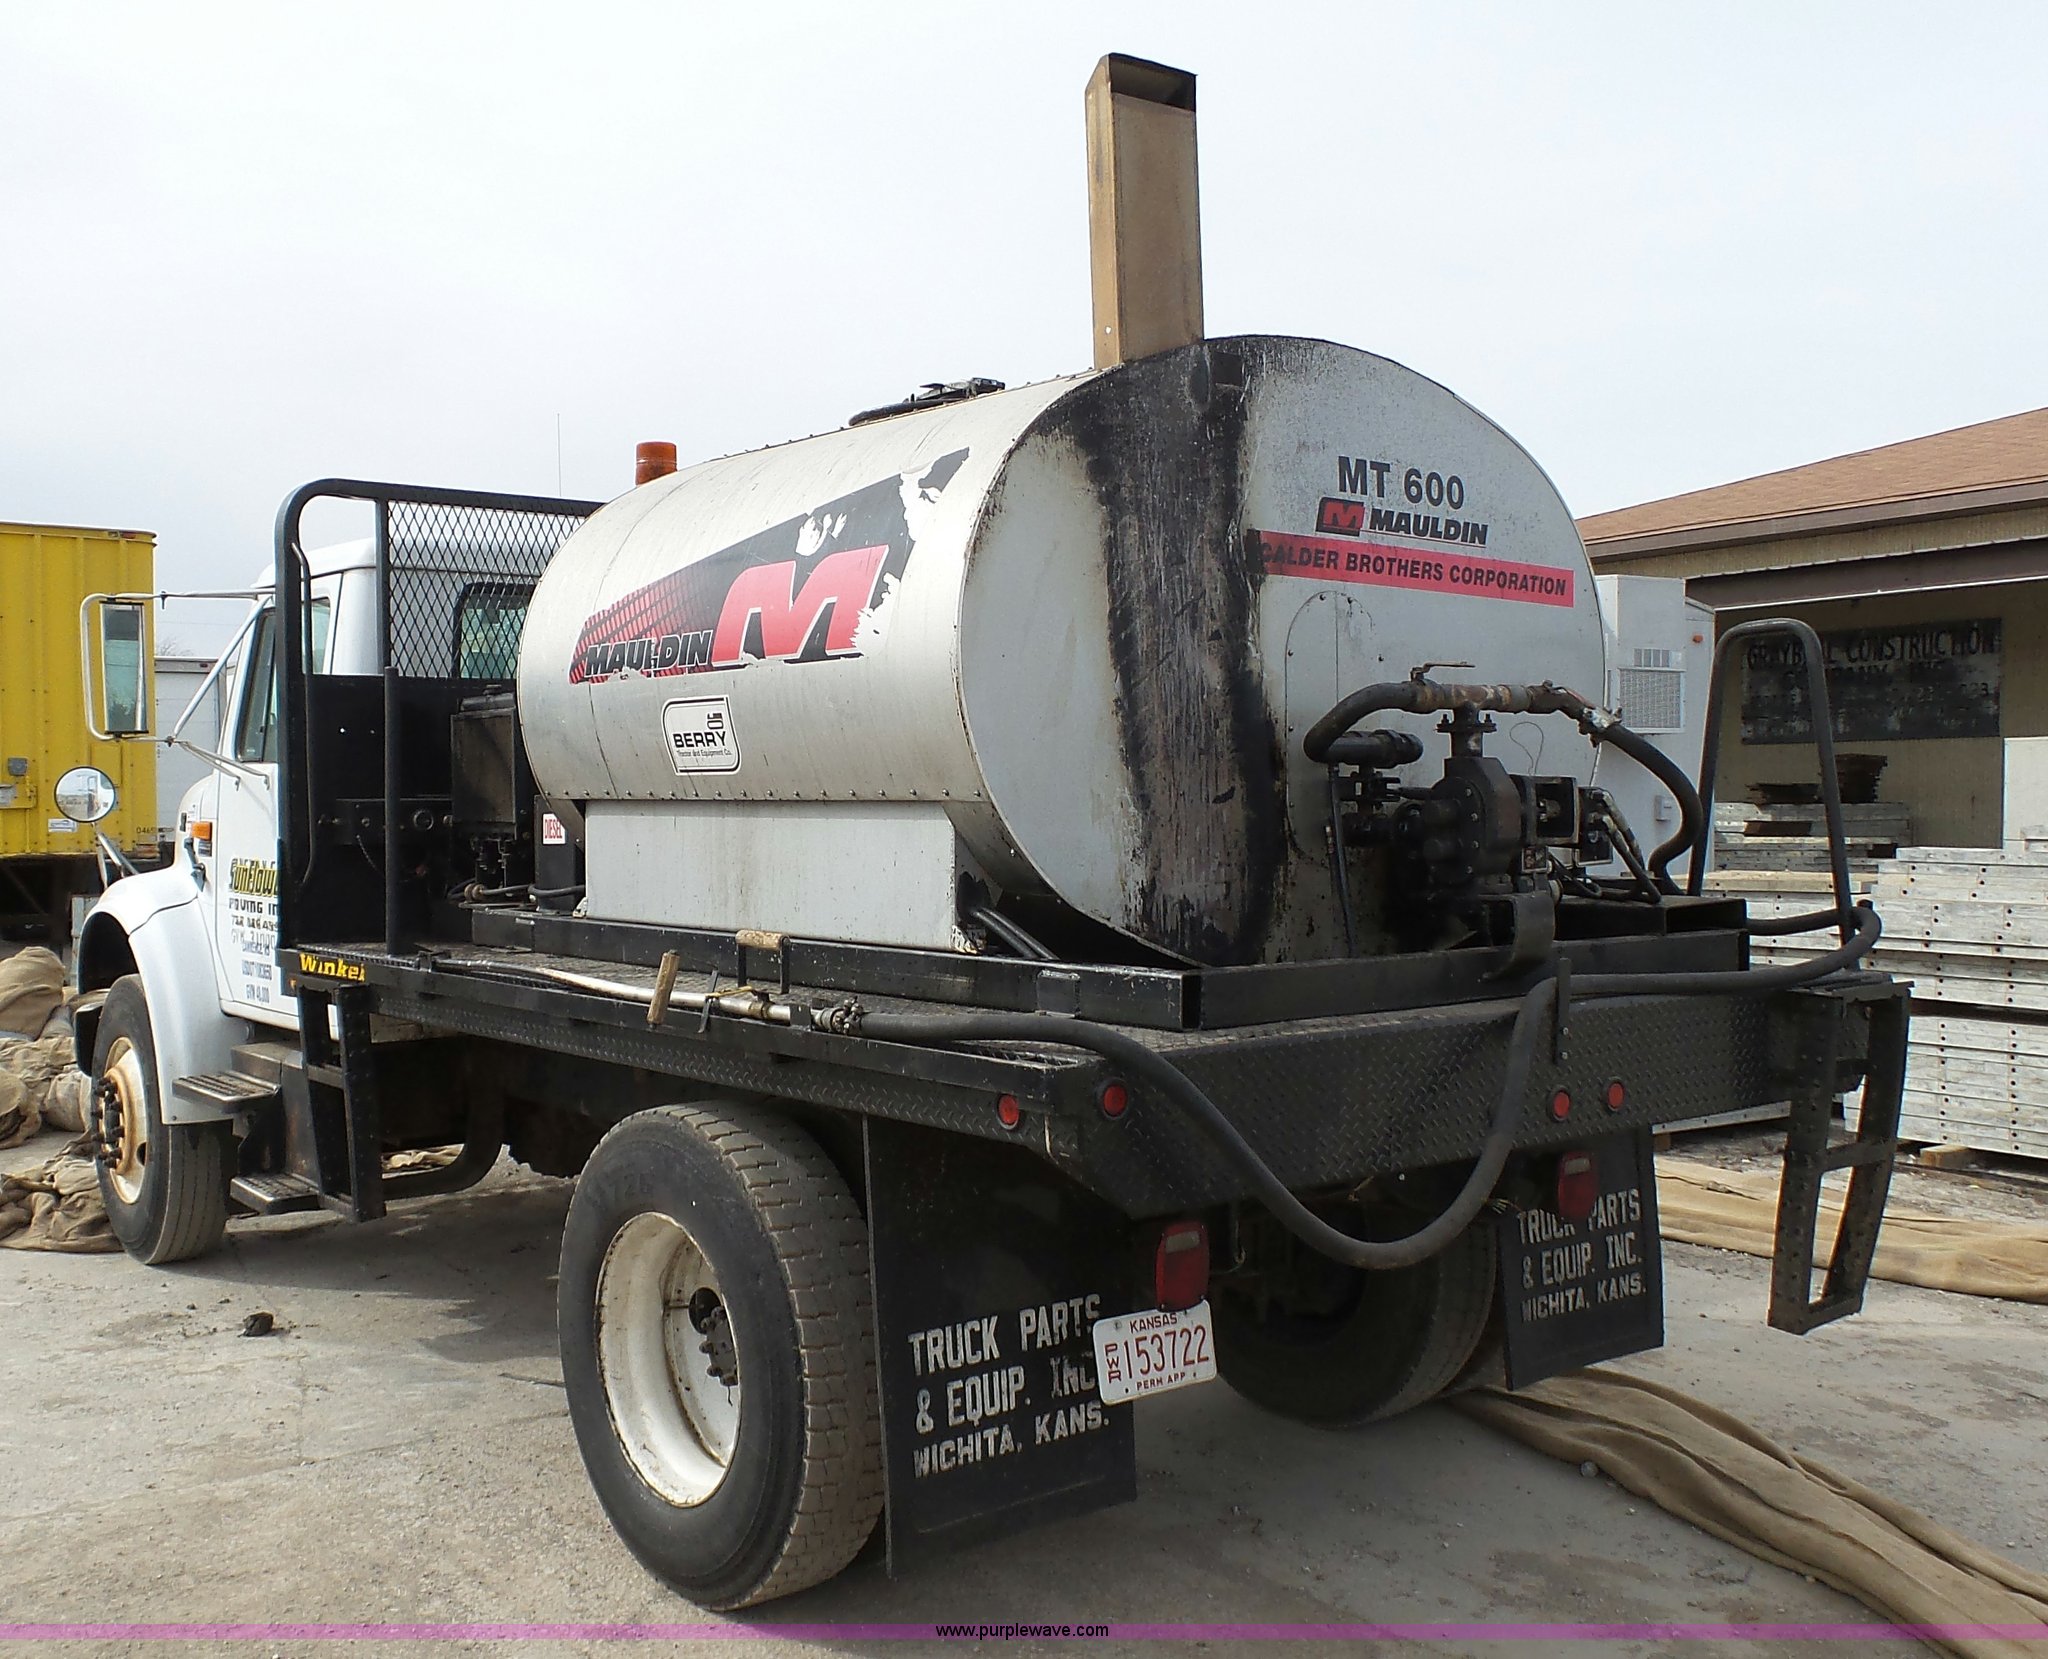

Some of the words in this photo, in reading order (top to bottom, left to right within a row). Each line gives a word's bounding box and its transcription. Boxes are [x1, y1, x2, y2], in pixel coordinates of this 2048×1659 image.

[1338, 456, 1391, 498] MT
[1404, 468, 1464, 509] 600
[1369, 508, 1488, 545] MAULDIN
[1345, 552, 1443, 581] BROTHERS
[1450, 564, 1566, 596] CORPORATION
[585, 630, 713, 677] MAULDIN
[673, 731, 726, 748] BERRY
[1522, 1255, 1534, 1289] &
[1605, 1232, 1642, 1270] INC.
[1597, 1272, 1646, 1303] KANS.
[907, 1315, 1001, 1376] TRUCK
[1129, 1312, 1178, 1334] KANSAS
[1123, 1324, 1209, 1379] 153722
[915, 1388, 934, 1434] &
[947, 1365, 1031, 1426] EQUIP.
[1167, 1372, 1186, 1384] APP
[1035, 1401, 1110, 1446] KANS.
